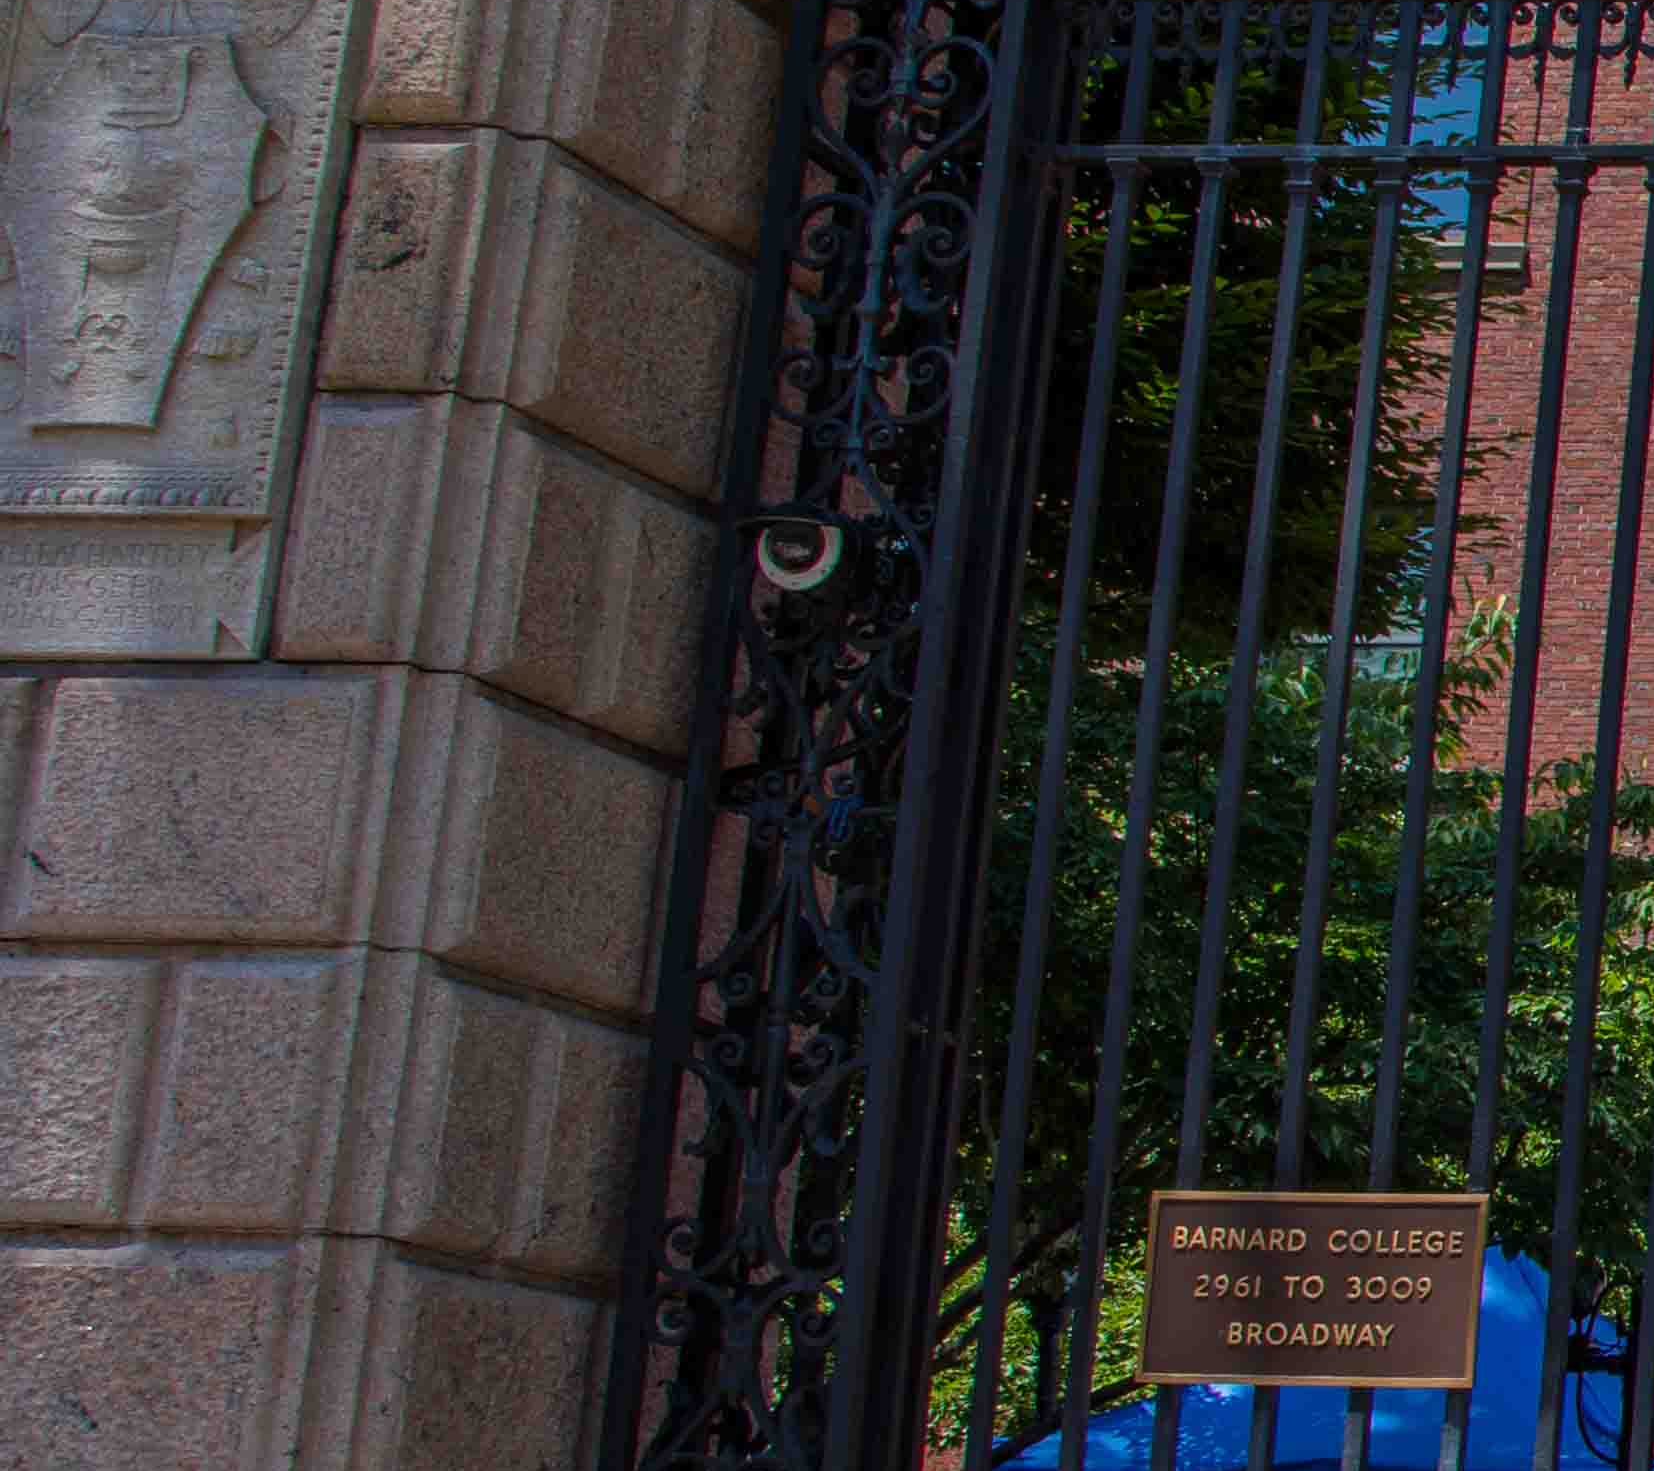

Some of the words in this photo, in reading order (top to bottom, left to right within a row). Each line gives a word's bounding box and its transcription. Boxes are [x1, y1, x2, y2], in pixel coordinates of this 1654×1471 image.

[1170, 1225, 1307, 1252] BARNARD
[1327, 1229, 1466, 1257] COLLEGE
[1192, 1273, 1262, 1299] 2961
[1284, 1275, 1326, 1300] TO
[1344, 1276, 1434, 1302] 3009
[1225, 1321, 1396, 1348] BROADWAY
